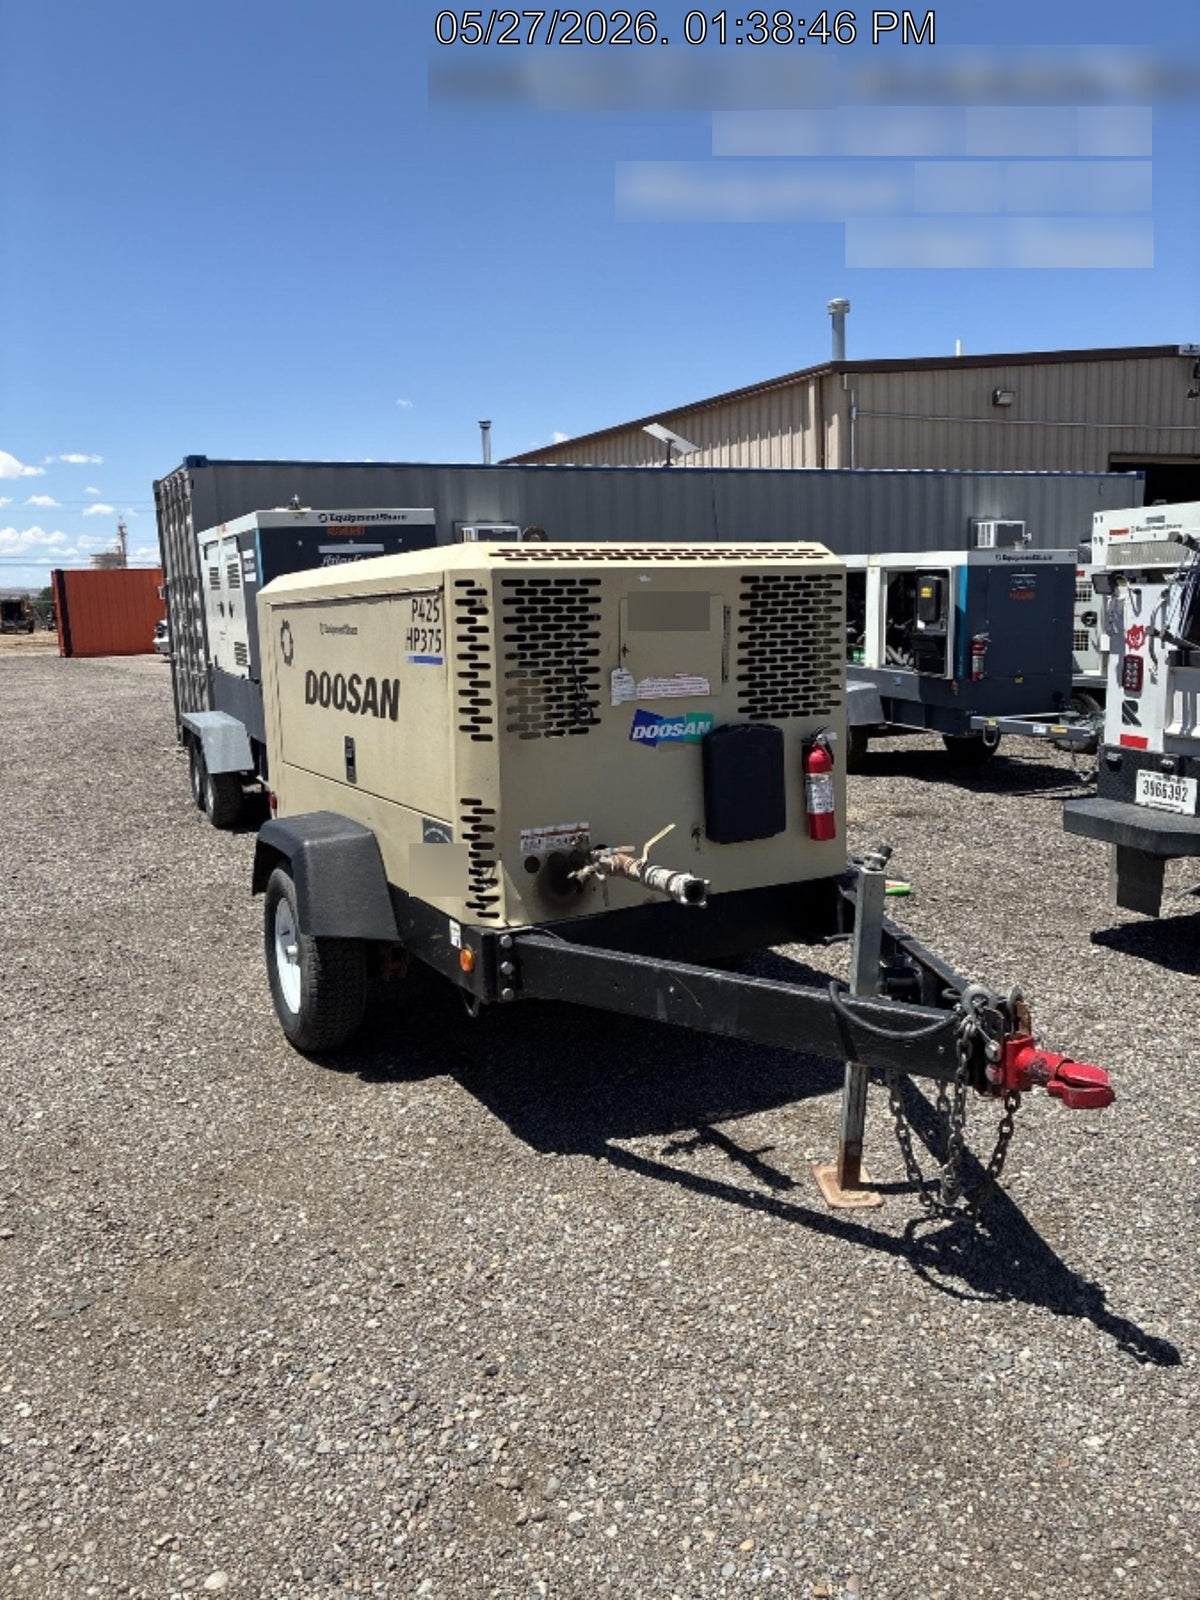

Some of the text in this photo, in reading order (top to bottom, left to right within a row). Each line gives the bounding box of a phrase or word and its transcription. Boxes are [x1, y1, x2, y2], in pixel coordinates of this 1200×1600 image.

[329, 513, 407, 523] EquipmentShare
[412, 598, 440, 623] P425
[406, 627, 442, 653] HP375
[305, 669, 400, 722] DOOSAN
[632, 721, 712, 740] DOOSAN
